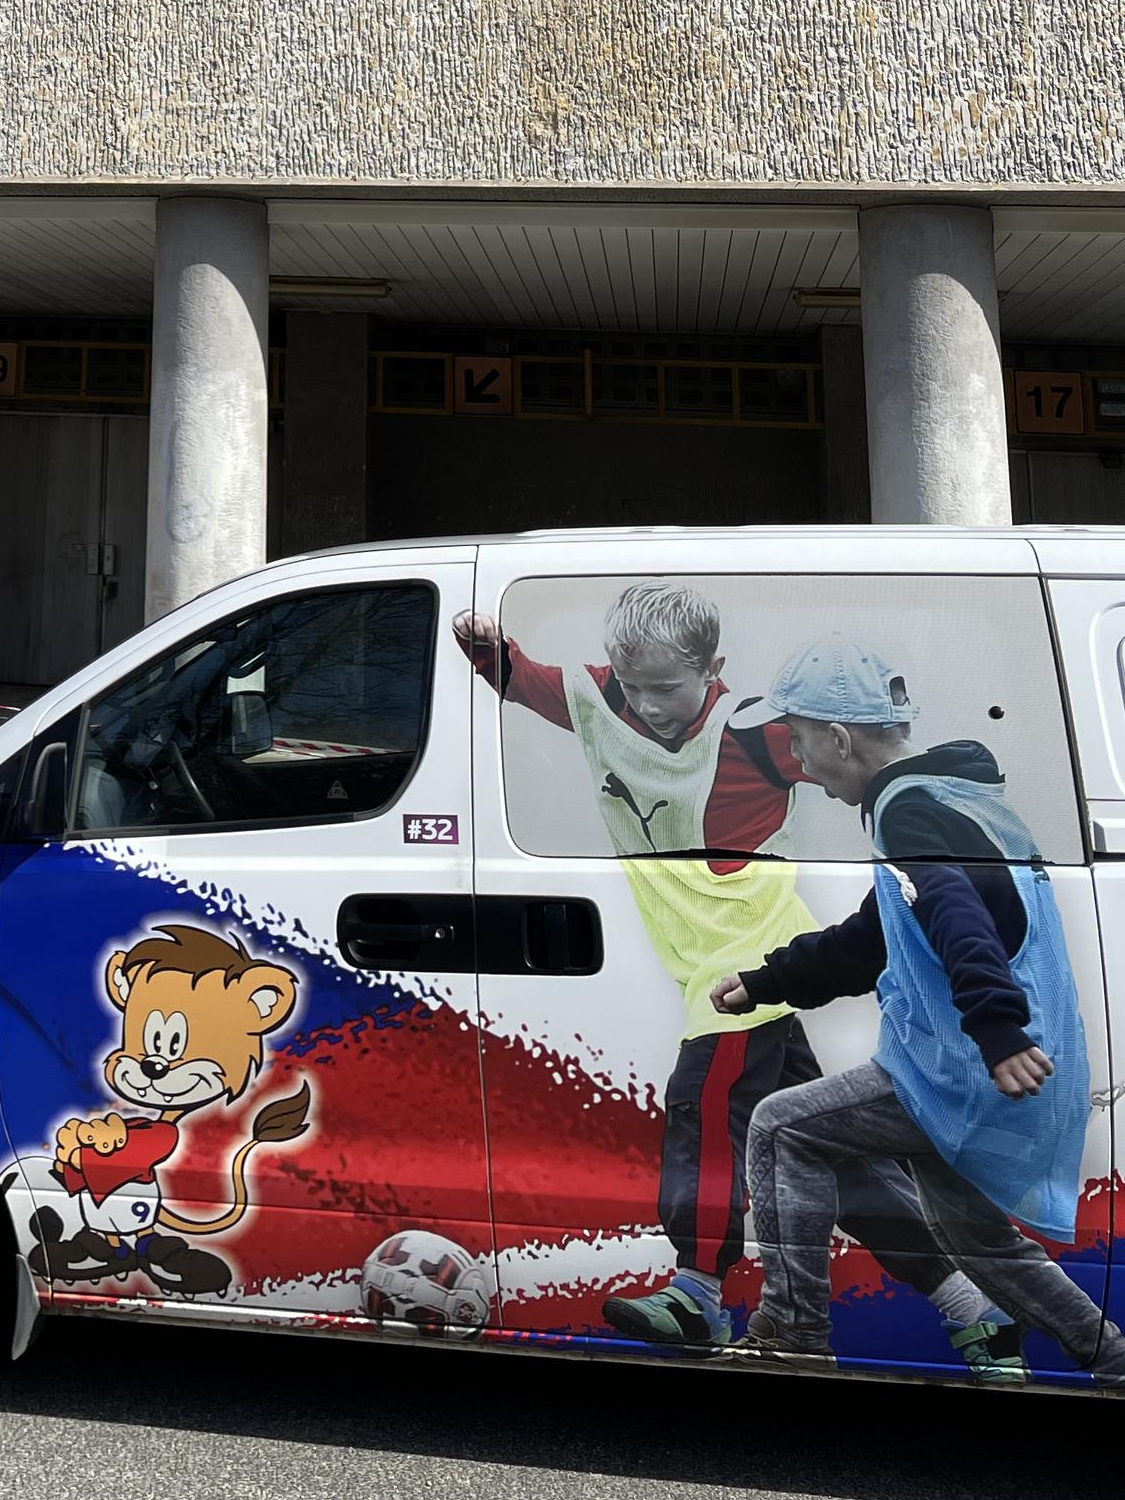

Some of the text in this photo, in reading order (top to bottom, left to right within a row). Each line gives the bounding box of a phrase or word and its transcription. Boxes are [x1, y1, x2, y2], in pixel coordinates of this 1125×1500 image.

[1026, 386, 1073, 418] 17
[407, 818, 453, 841] #32
[131, 1201, 150, 1223] 9
